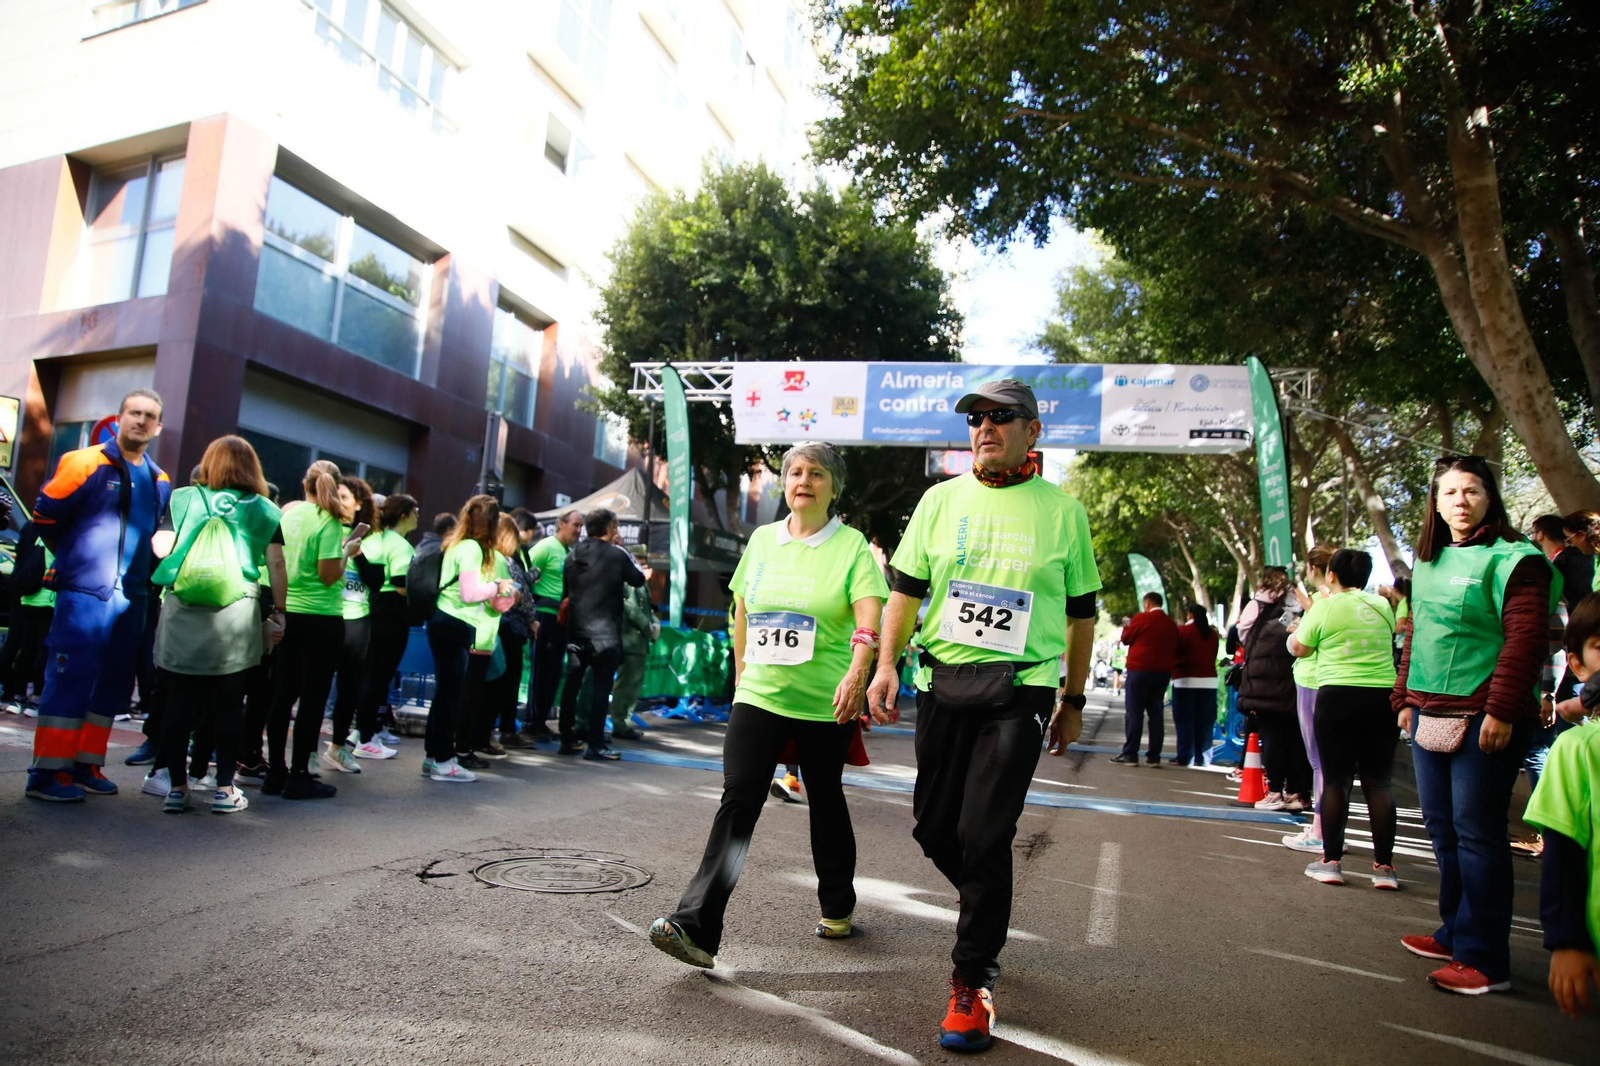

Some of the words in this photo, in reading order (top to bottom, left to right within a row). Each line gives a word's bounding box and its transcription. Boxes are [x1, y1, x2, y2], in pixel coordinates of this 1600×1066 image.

[880, 371, 964, 388] Almería
[1131, 375, 1176, 388] cajamar
[879, 395, 949, 412] contra
[956, 516, 969, 566] ALMERÍA
[989, 530, 1035, 544] marcha
[970, 541, 1015, 553] contra
[1019, 544, 1033, 556] el
[968, 552, 1032, 573] cáncer
[346, 580, 365, 593] 600
[958, 602, 1013, 631] 542
[757, 628, 799, 648] 316
